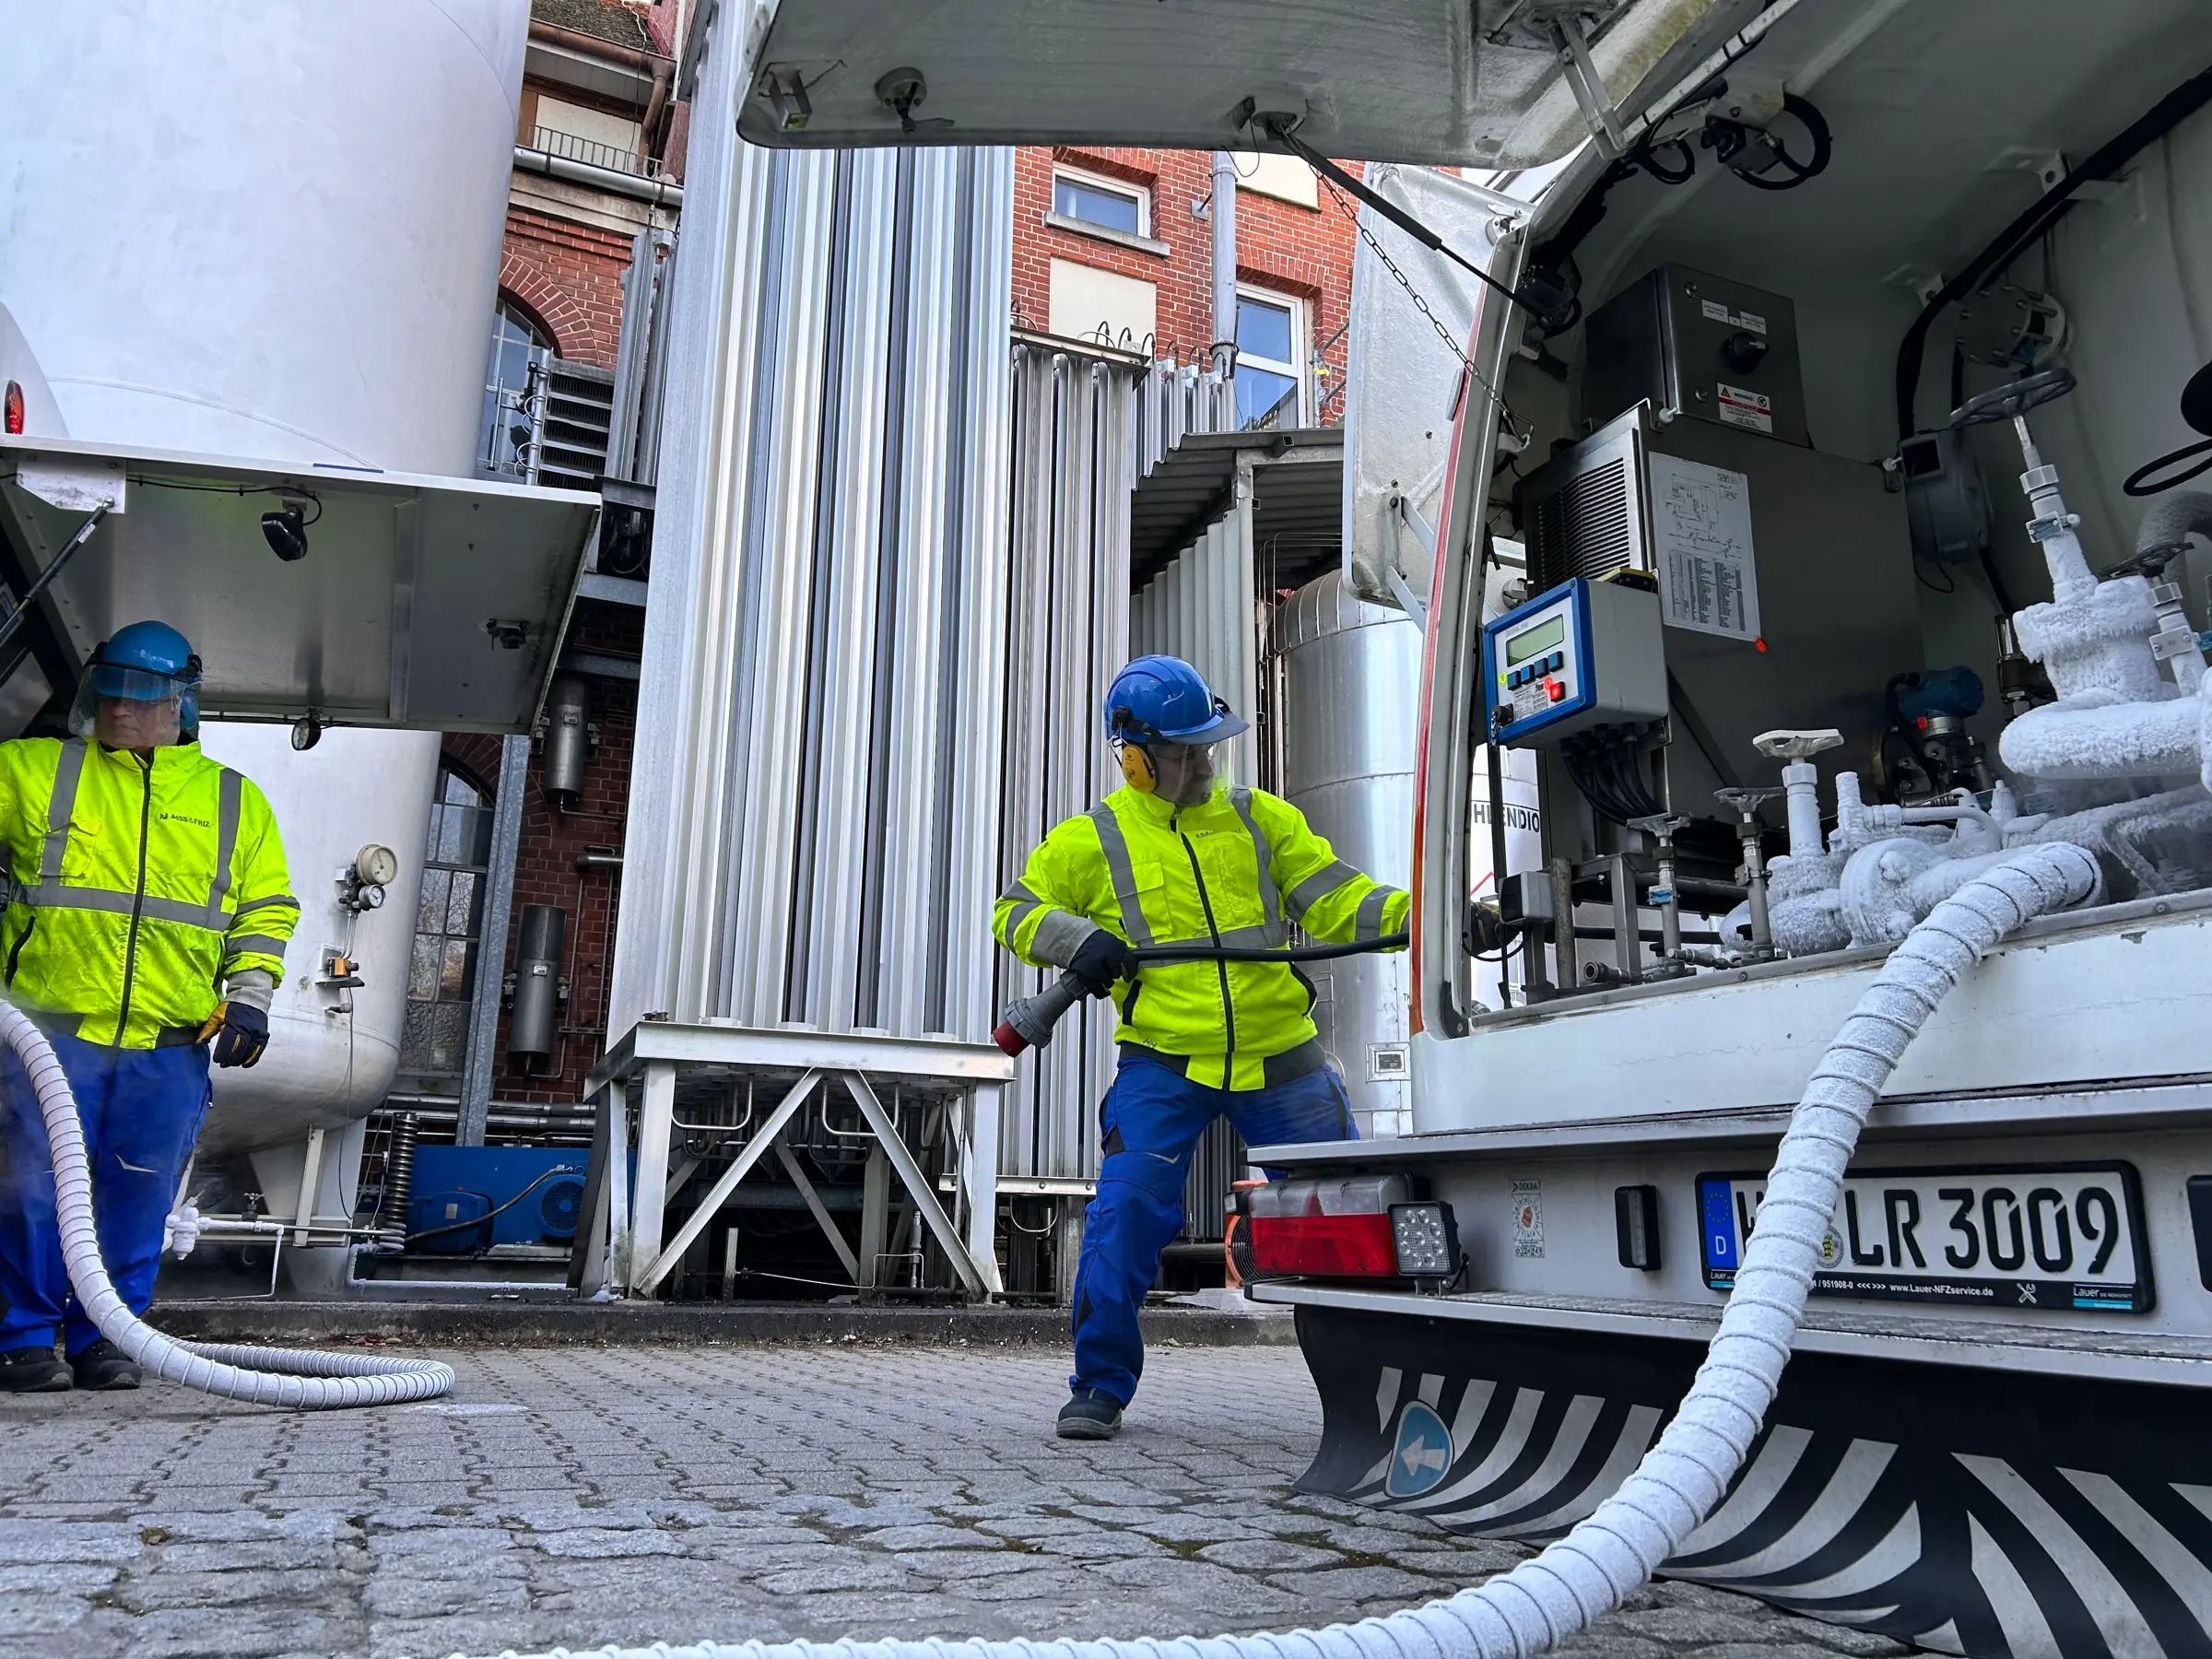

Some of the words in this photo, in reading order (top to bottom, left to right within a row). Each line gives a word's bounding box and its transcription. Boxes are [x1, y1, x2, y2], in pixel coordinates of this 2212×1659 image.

[1519, 1182, 1538, 1191] DEKRA
[1845, 1188, 1926, 1267] LR
[1938, 1187, 2119, 1274] 3009
[1715, 1236, 1726, 1254] D
[1822, 1279, 1853, 1289] 951908-0
[1889, 1284, 1994, 1296] www.Lauer-NFZservice.de
[2073, 1286, 2100, 1297] Lauer
